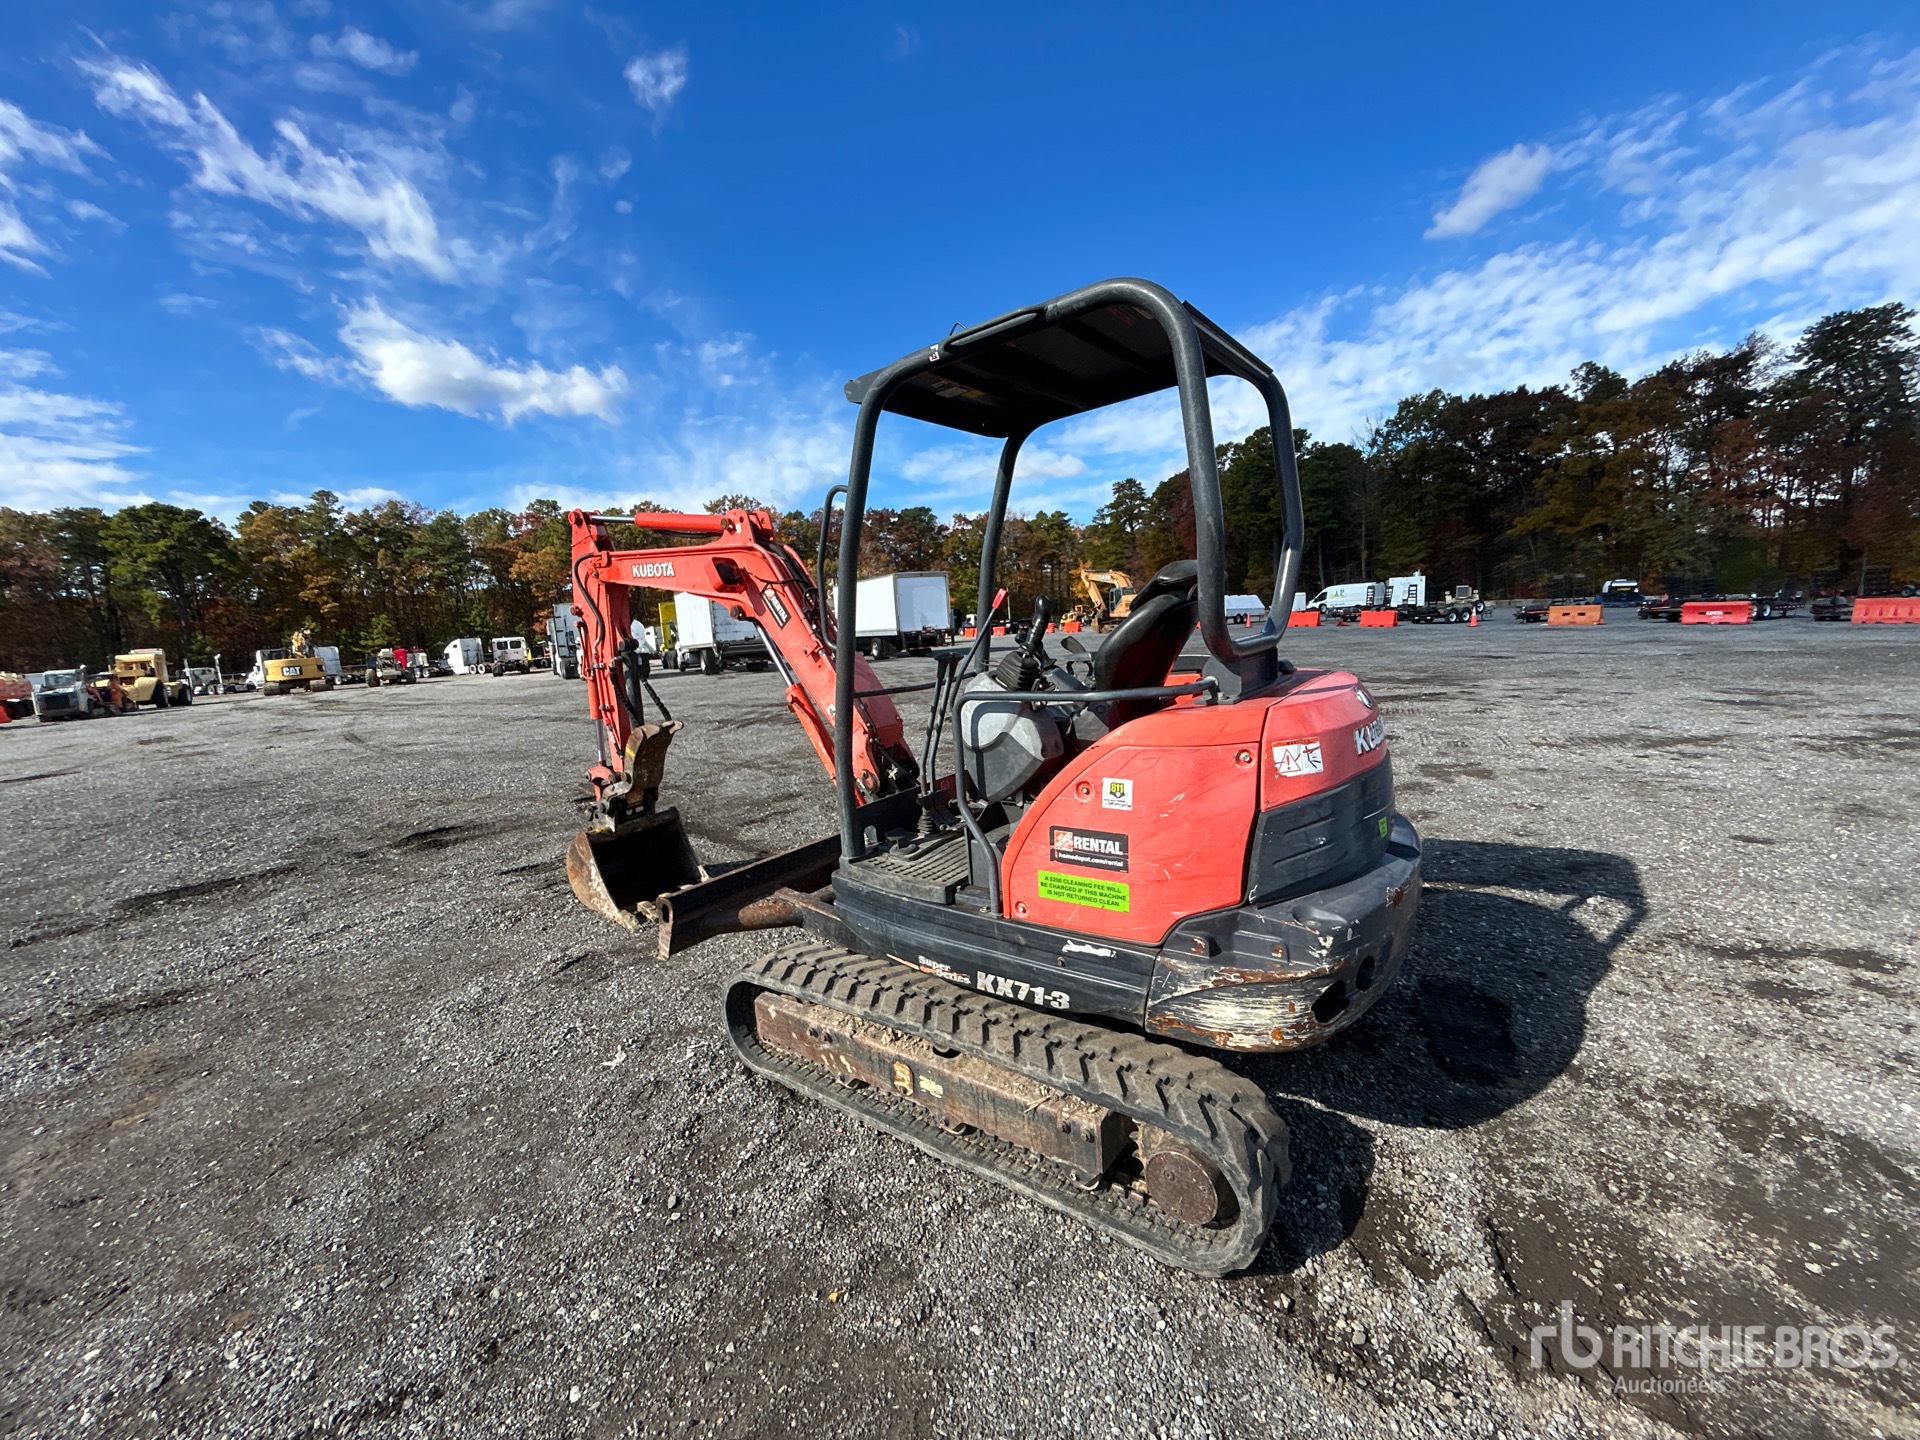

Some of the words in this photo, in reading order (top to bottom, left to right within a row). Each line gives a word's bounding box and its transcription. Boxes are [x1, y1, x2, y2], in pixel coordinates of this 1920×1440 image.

[632, 561, 675, 578] KUBOTA
[282, 666, 301, 676] CAT
[1111, 783, 1124, 793] 811
[1073, 835, 1124, 856] RENTAL
[1058, 852, 1124, 867] homedepot.com/rental
[1049, 882, 1077, 893] CHARGED
[1098, 891, 1127, 902] MACHINE
[1063, 878, 1092, 889] CLEANING
[1093, 883, 1105, 891] FEE
[1106, 886, 1121, 894] WILL
[1066, 892, 1098, 903] RETURNED
[1098, 898, 1120, 907] CLEAN
[918, 955, 951, 972] Super
[935, 969, 971, 985] Series
[976, 971, 1071, 1010] KX71-3
